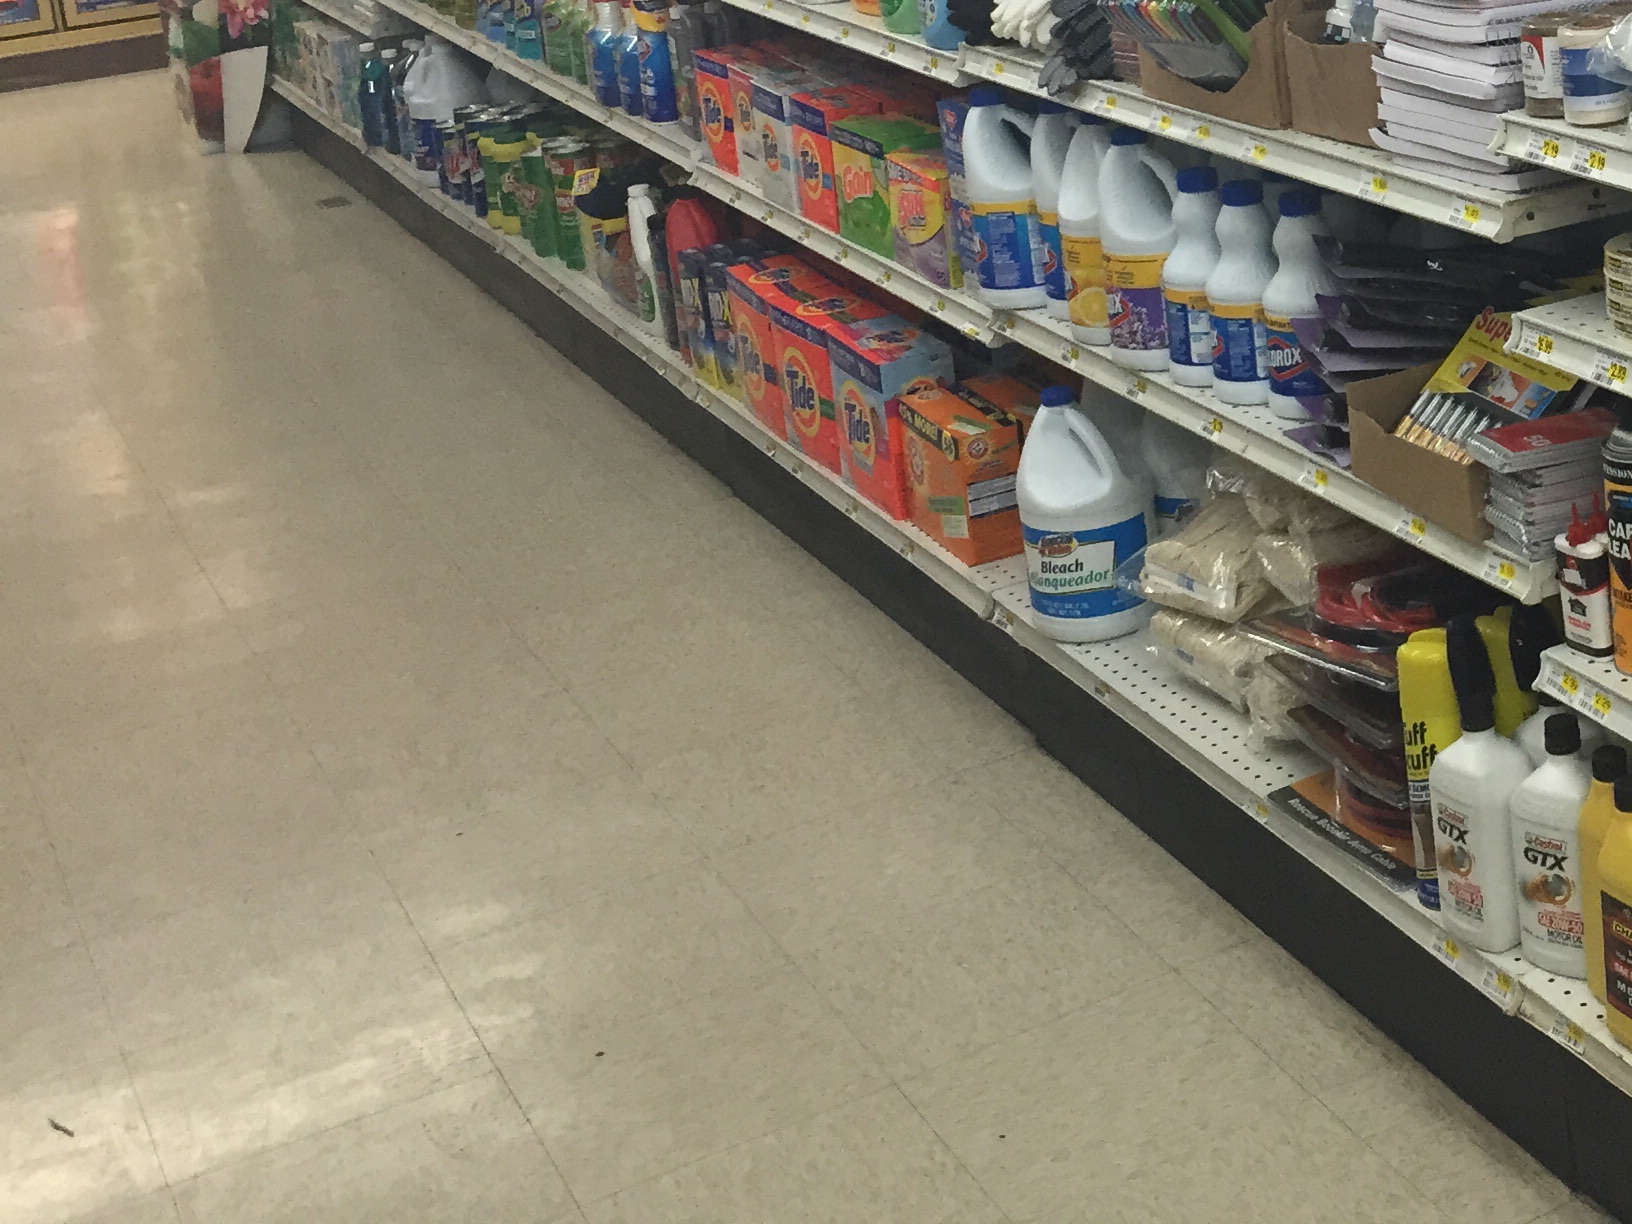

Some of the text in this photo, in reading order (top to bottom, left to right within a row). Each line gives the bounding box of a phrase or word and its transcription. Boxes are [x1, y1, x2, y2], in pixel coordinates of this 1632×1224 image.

[1041, 558, 1084, 574] Bleach
[1437, 816, 1469, 845] GTX
[1523, 846, 1568, 873] GTX
